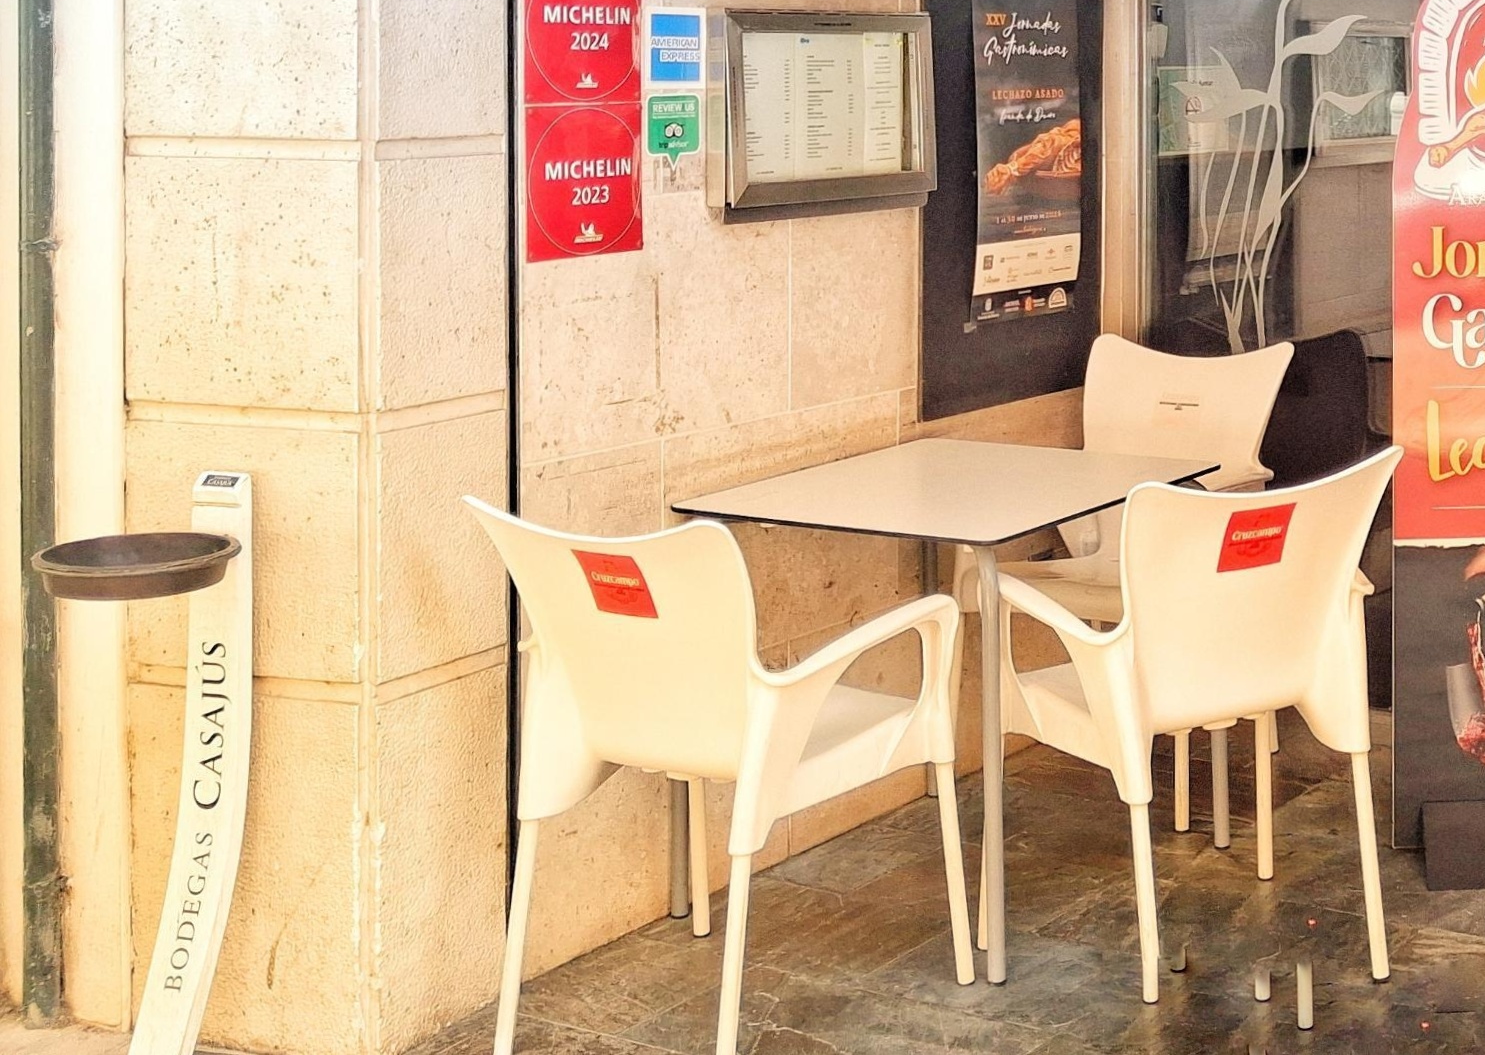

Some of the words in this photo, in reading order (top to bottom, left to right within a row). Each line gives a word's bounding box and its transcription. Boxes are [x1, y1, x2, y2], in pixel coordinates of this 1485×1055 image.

[543, 5, 631, 25] MICHELIN
[985, 13, 1007, 26] XXV
[570, 32, 610, 51] 2024
[650, 37, 698, 48] AMERICAN
[661, 51, 700, 62] EXPRESS
[992, 89, 1032, 100] LECHAZO
[1035, 88, 1065, 99] ASADO
[652, 103, 682, 113] REVIEW
[684, 103, 695, 112] US
[545, 158, 632, 181] MICHELIN
[572, 186, 610, 205] 2023
[163, 831, 215, 994] BODEGAS
[192, 639, 229, 811] CASAJÚS
